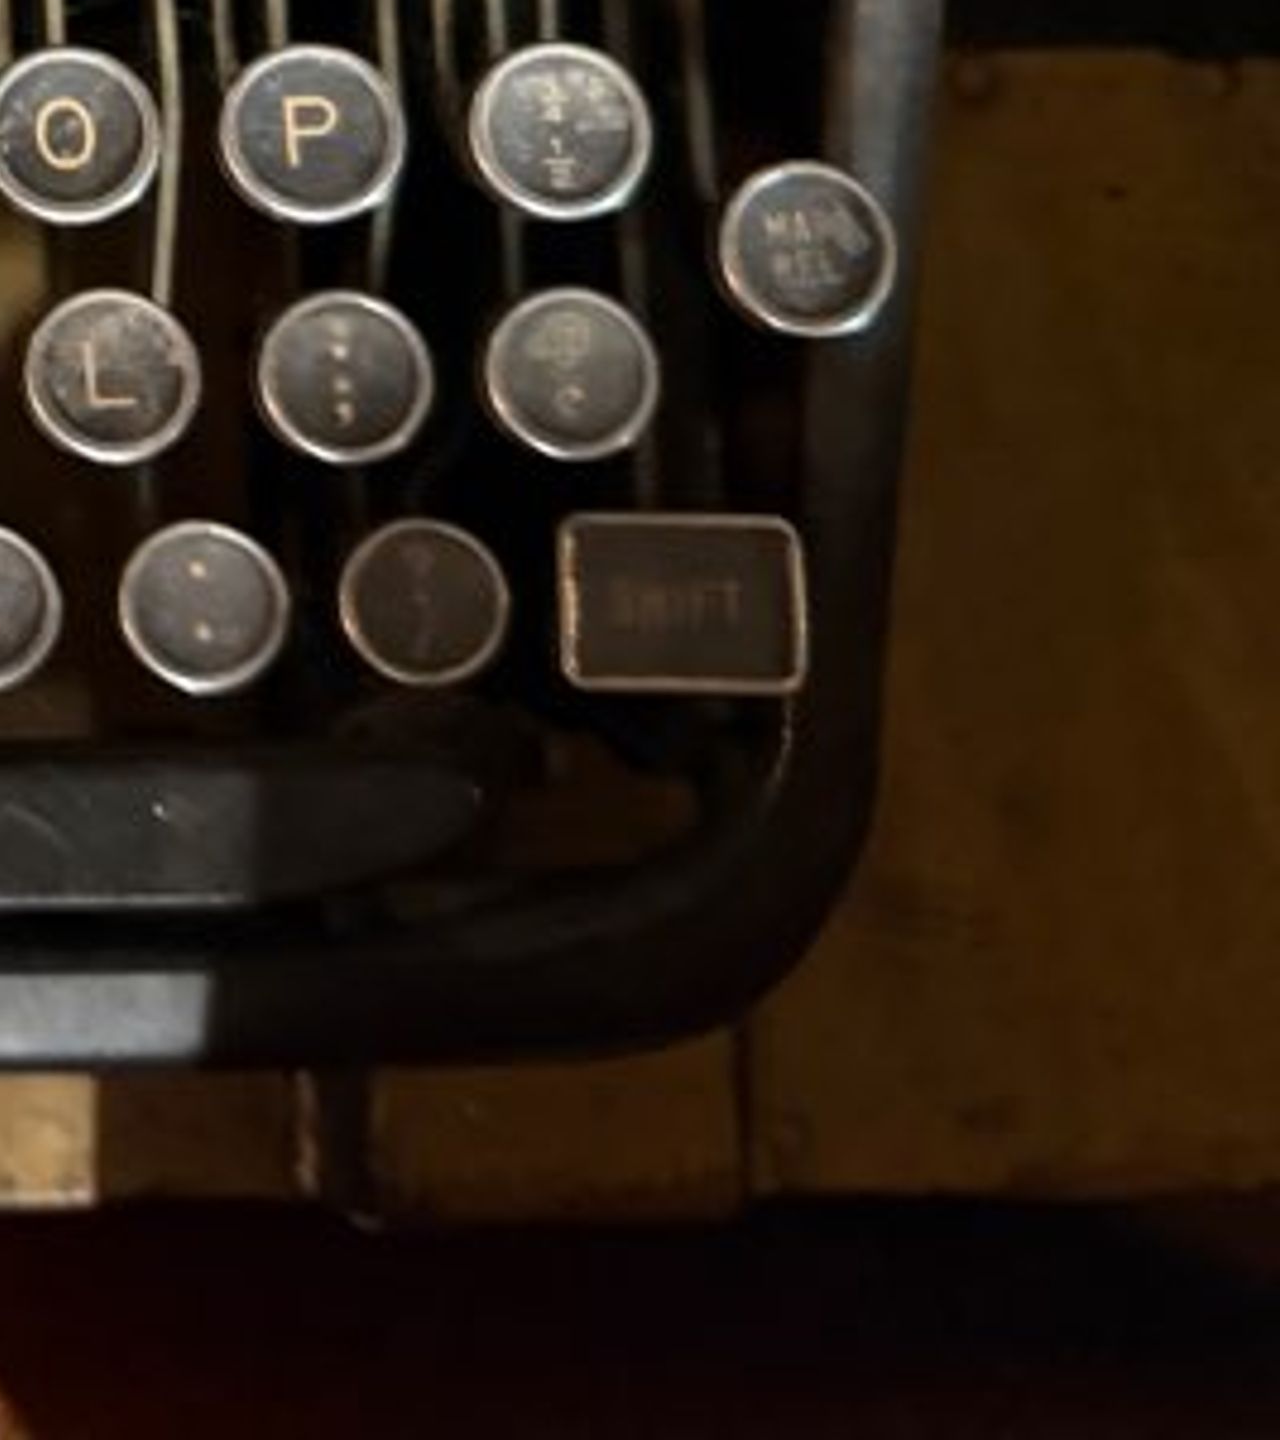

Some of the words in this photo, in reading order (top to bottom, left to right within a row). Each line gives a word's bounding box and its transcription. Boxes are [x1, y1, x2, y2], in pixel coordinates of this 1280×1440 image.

[36, 98, 96, 168] O
[283, 97, 338, 166] P
[83, 340, 137, 406] L
